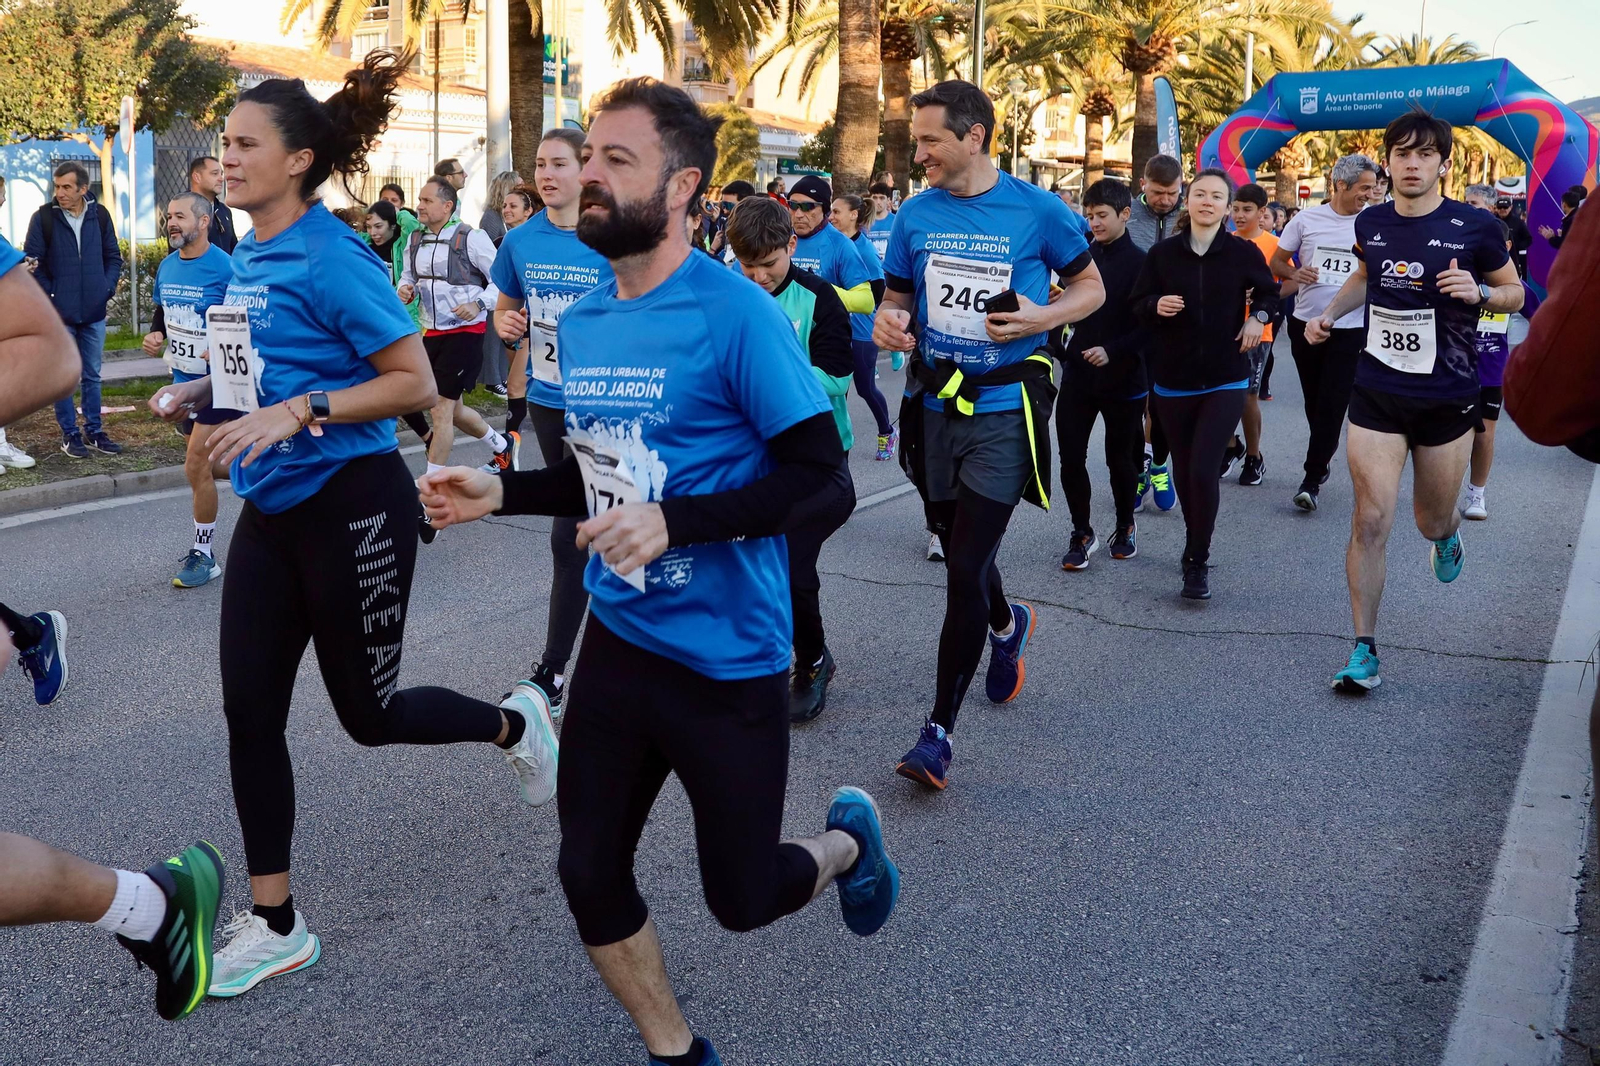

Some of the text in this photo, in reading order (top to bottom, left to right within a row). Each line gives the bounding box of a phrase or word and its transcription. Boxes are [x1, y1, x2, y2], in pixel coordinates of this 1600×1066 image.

[1325, 85, 1470, 104] Ayuntamiento de Málaga
[1325, 103, 1342, 112] Área
[1354, 103, 1382, 112] Deporte
[936, 232, 969, 240] CARRERA
[970, 234, 999, 242] URBANA
[924, 240, 1010, 254] CIUDAD JARDÍN
[1442, 242, 1464, 250] mupol
[563, 265, 590, 274] URBANA
[1322, 258, 1352, 274] 413
[1381, 259, 1424, 279] 200
[525, 270, 598, 284] CIUDAD JARDÍN
[181, 290, 204, 298] JARDÍN
[258, 285, 270, 294] DE
[1380, 283, 1422, 291] NACIONAL
[940, 284, 990, 314] 246
[171, 339, 196, 358] 551
[952, 337, 978, 347] febrero
[1381, 330, 1421, 352] 388
[219, 342, 248, 376] 256
[576, 367, 611, 377] CARRERA
[612, 367, 650, 378] URBANA
[652, 368, 666, 379] DE
[564, 378, 664, 399] CIUDAD JARDÍN
[590, 483, 624, 516] 17
[349, 511, 400, 634] NIKE
[367, 642, 400, 709] AIR
